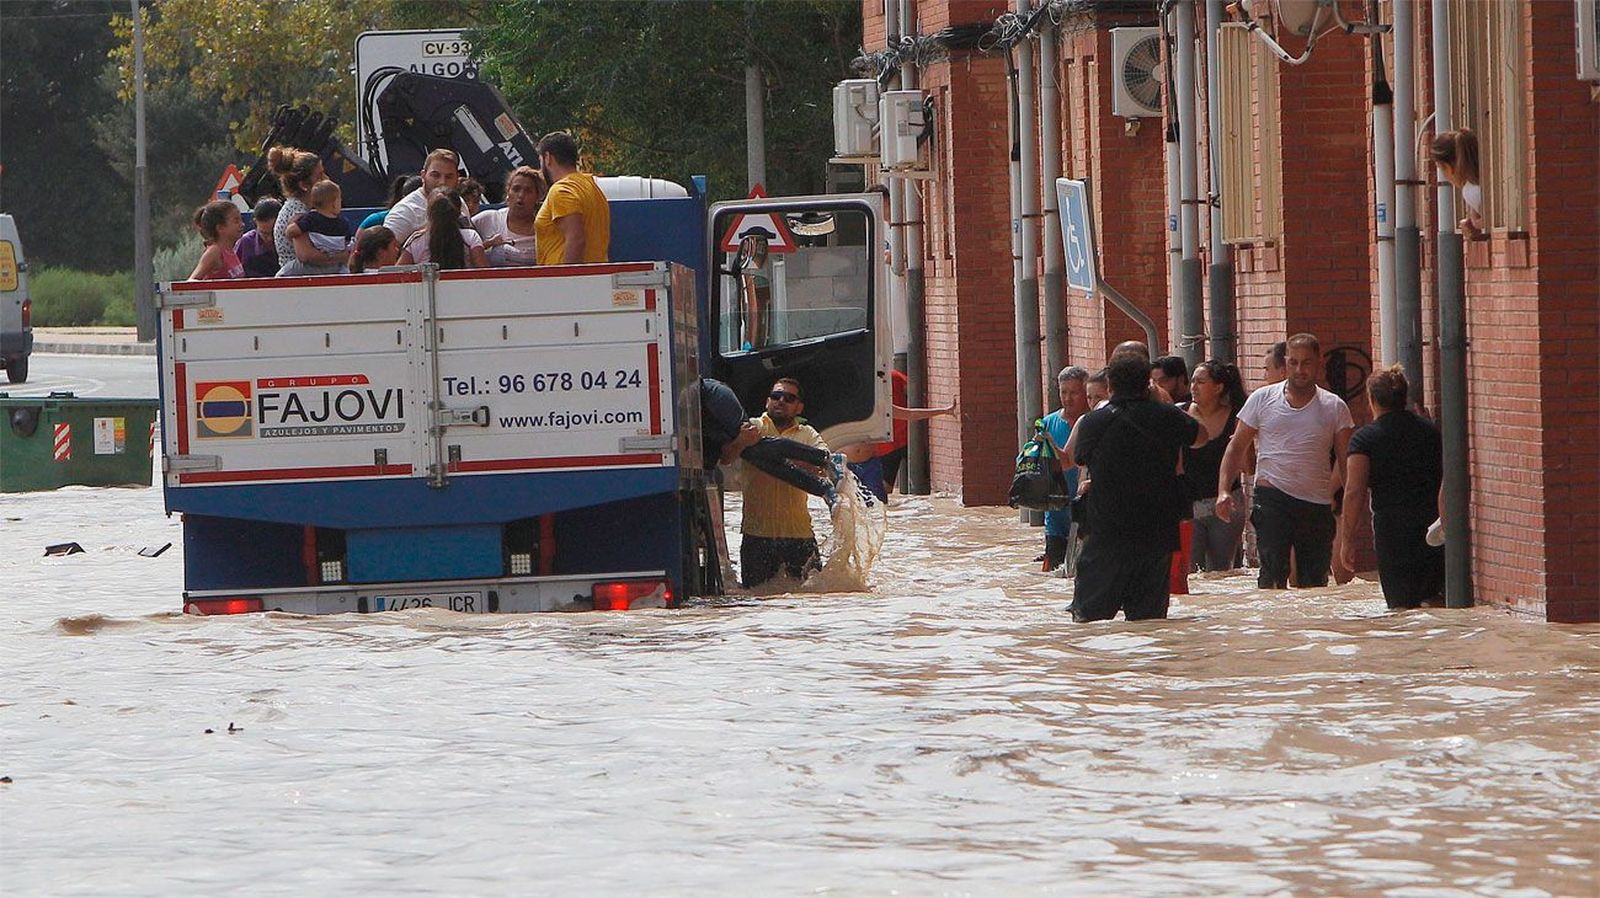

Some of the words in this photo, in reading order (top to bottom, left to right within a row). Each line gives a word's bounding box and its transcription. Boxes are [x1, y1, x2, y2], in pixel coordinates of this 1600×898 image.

[268, 376, 358, 387] GRUPO
[443, 376, 490, 395] Tel.:
[499, 374, 525, 394] 96
[533, 372, 573, 392] 678
[581, 370, 607, 390] 04
[615, 369, 642, 389] 24
[258, 389, 404, 424] FAJOVI
[500, 410, 643, 429] www.fajovi.com
[265, 427, 317, 437] AZULEJOS
[322, 426, 327, 434] Y
[333, 424, 399, 434] PAVIMENTOS
